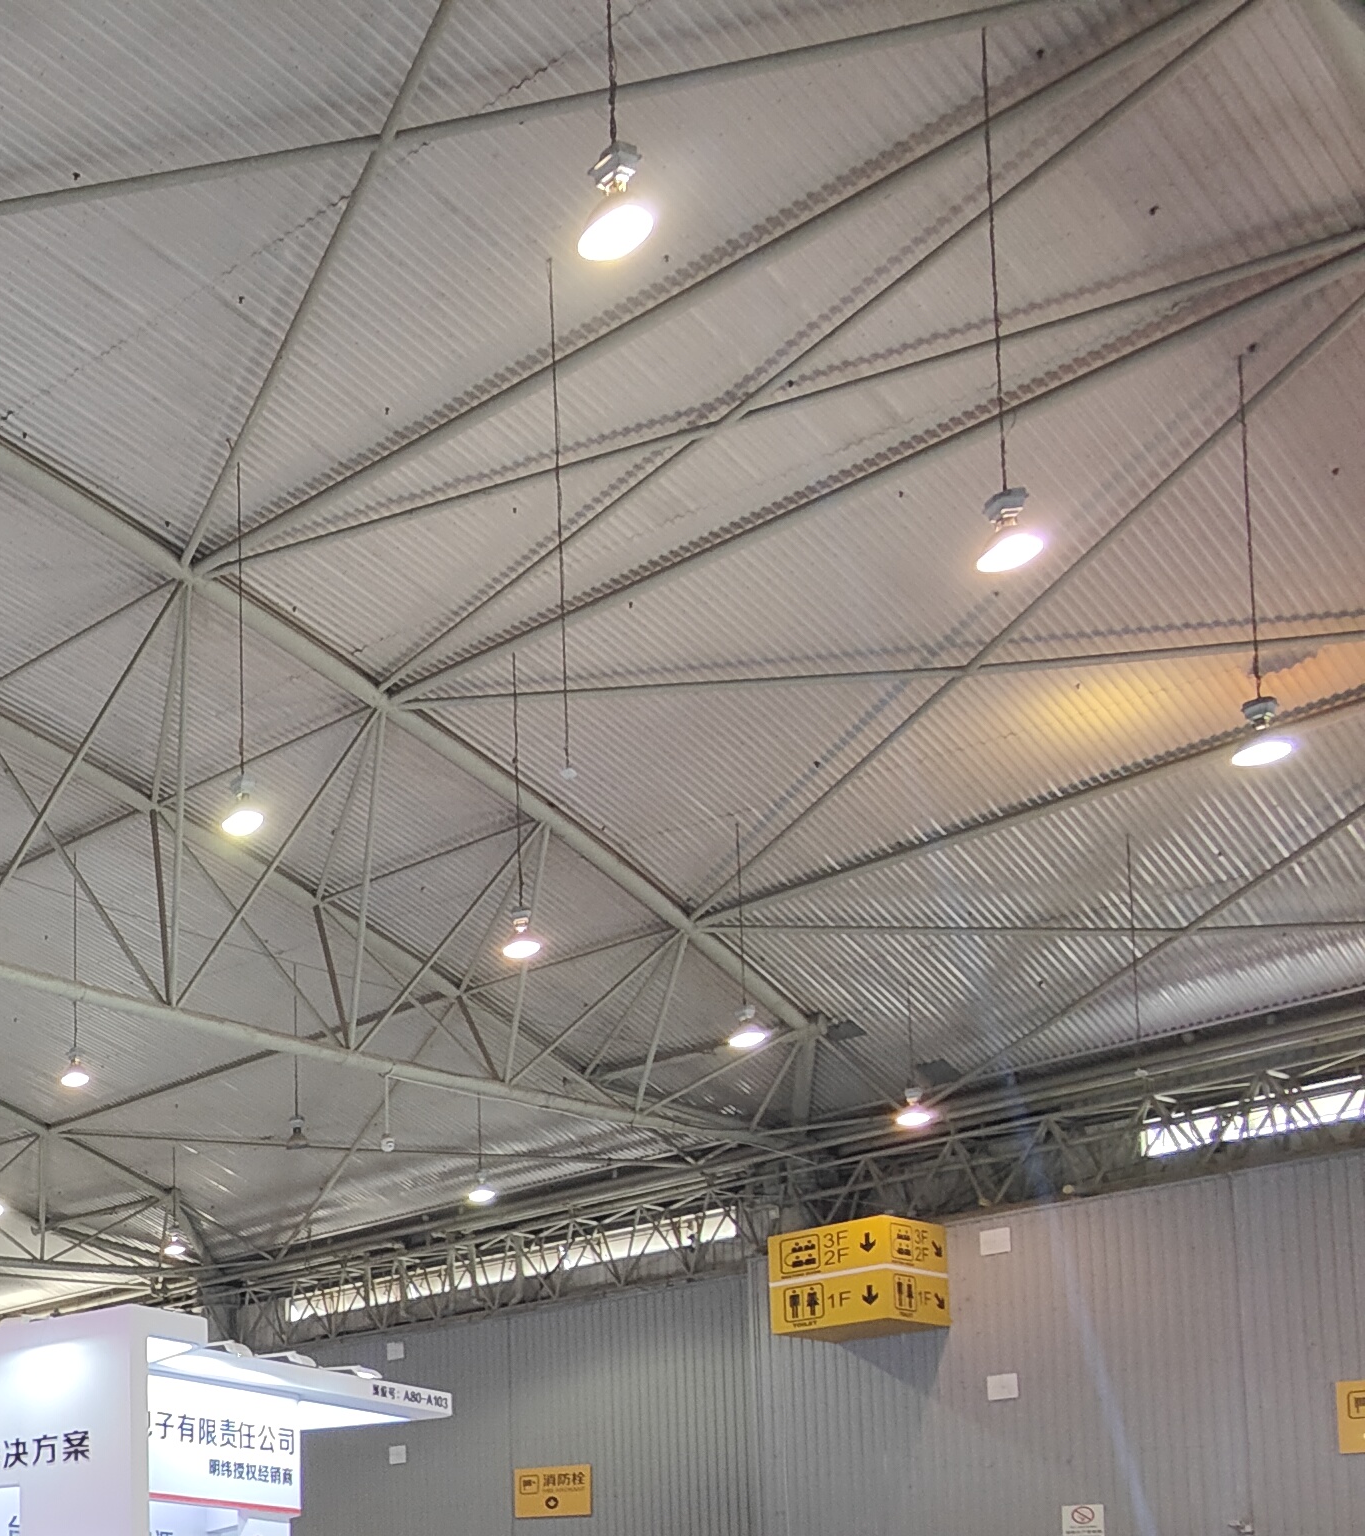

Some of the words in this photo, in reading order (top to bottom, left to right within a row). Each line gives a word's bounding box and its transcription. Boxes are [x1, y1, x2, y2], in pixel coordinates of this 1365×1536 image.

[823, 1230, 849, 1248] 3F
[914, 1229, 928, 1245] 3F
[824, 1247, 850, 1266] 2F
[915, 1247, 929, 1262] 2F
[827, 1291, 851, 1309] 1F
[919, 1291, 932, 1306] 1F
[403, 1390, 449, 1409] A80-A103
[147, 1411, 295, 1455] 子有限责任公司
[209, 1459, 293, 1486] 明纬授权经销商
[543, 1471, 586, 1488] 消防栓
